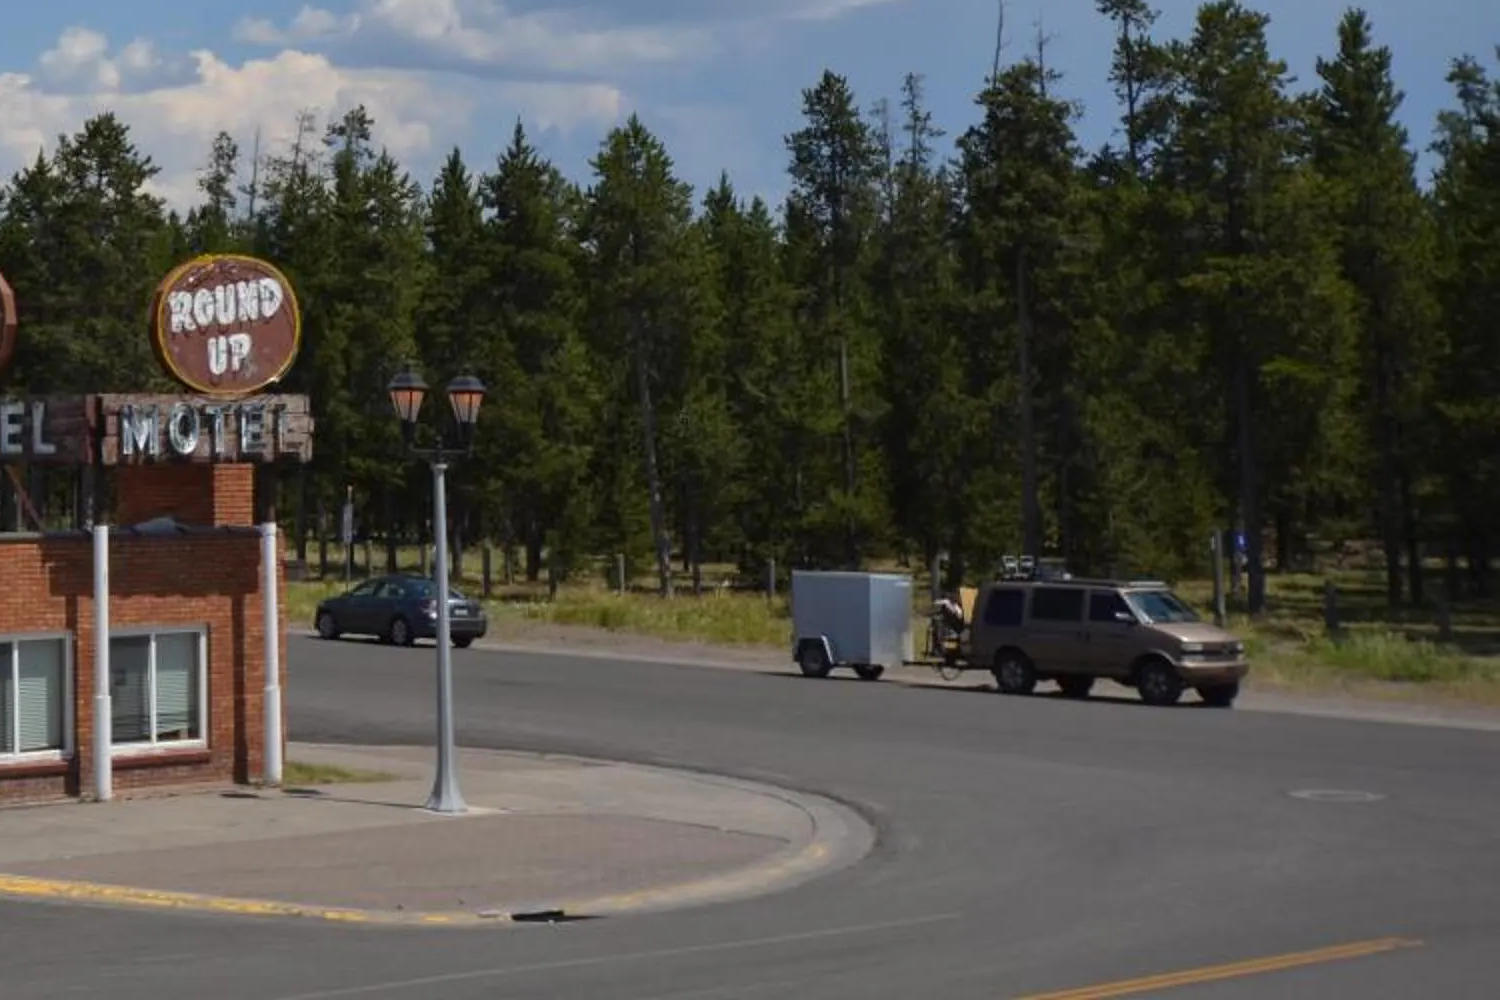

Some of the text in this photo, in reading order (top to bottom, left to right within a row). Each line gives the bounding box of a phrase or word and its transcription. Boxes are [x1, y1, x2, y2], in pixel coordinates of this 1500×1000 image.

[168, 277, 284, 333] ROUND
[207, 333, 252, 376] UP
[122, 402, 300, 455] MOTEL
